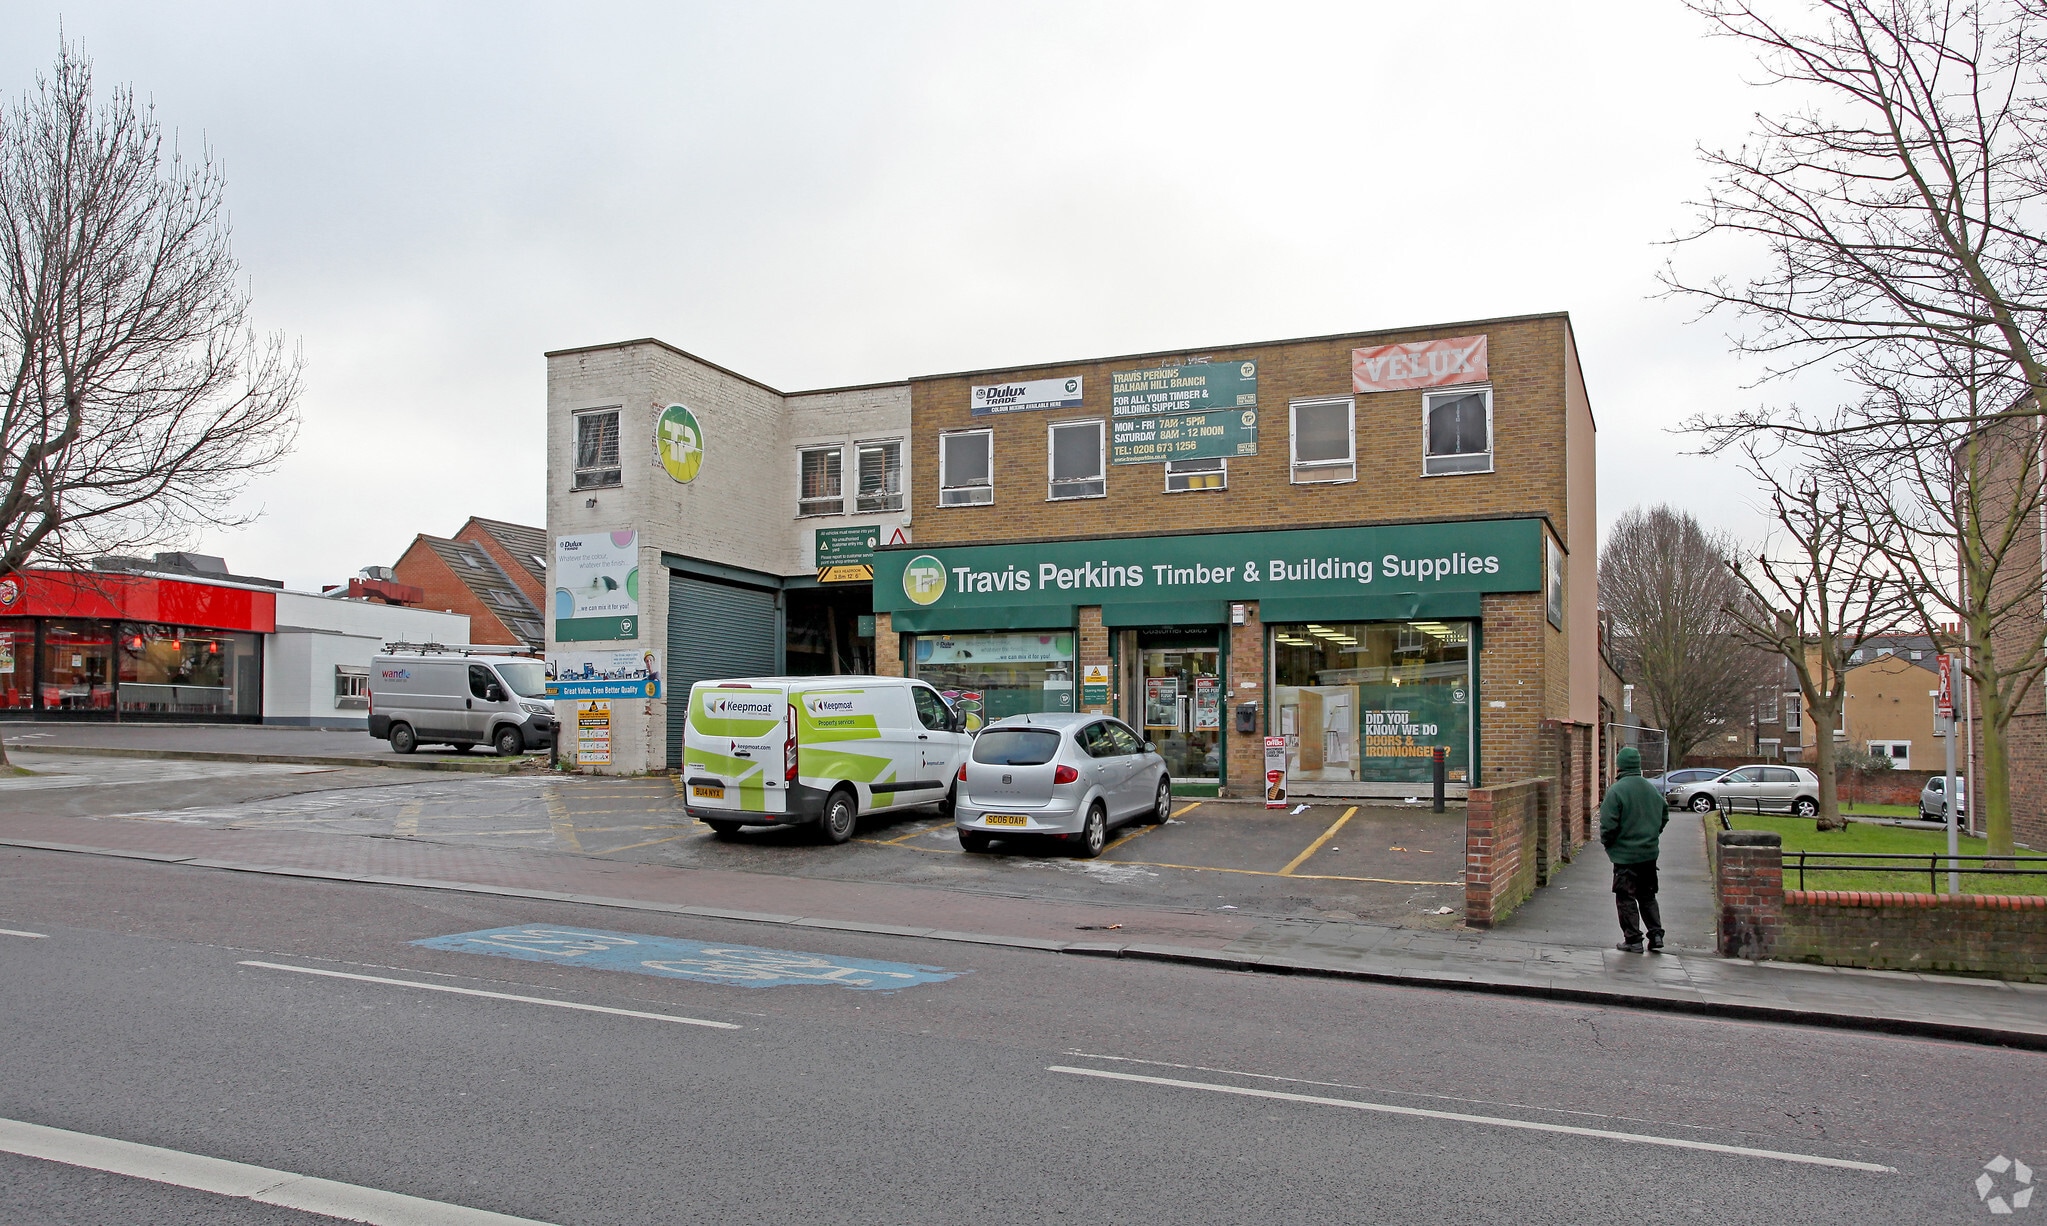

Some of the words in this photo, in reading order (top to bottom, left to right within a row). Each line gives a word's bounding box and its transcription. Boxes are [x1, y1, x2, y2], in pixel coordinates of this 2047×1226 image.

[1113, 372, 1142, 384] TRAVIS
[1144, 369, 1179, 381] PERKINS
[1114, 381, 1149, 393] BALHAM
[1151, 379, 1169, 391] HILL
[1171, 376, 1206, 388] BRANCH
[986, 386, 1027, 399] Dulux
[1114, 396, 1129, 406] FOR
[1130, 395, 1146, 405] ALL
[1148, 392, 1168, 403] YOUR
[1169, 390, 1200, 401] TIMBER
[1202, 390, 1209, 398] &
[986, 397, 1017, 405] TRADE
[1026, 402, 1049, 410] AVAILABLE
[1114, 404, 1151, 416] BUILDING
[1152, 401, 1191, 413] SUPPLIES
[1115, 422, 1134, 432] MON
[1142, 420, 1155, 431] FRI
[1159, 418, 1179, 429] 7AM
[1186, 416, 1206, 427] 5PM
[1115, 431, 1156, 444] SATURDAY
[1160, 430, 1180, 440] 8AM
[1188, 428, 1199, 438] 12
[1200, 426, 1225, 436] NOON
[665, 420, 697, 464] TP
[1114, 446, 1132, 456] TEL:
[1134, 444, 1155, 455] 0208
[1156, 442, 1173, 453] 673
[1175, 441, 1197, 451] 1256
[952, 565, 1030, 593] Travis
[1039, 561, 1144, 590] Perkins
[1152, 562, 1235, 586] Timber
[1243, 561, 1261, 583] &
[1269, 558, 1373, 584] Building
[1382, 552, 1500, 581] Supplies
[910, 567, 939, 593] TP
[382, 669, 410, 679] wandle
[578, 686, 592, 695] Value,
[593, 686, 605, 695] Even
[605, 686, 620, 694] Better
[621, 685, 638, 695] Quality
[728, 701, 772, 713] Keepmoat
[824, 701, 853, 711] Keepmoat
[1366, 714, 1384, 724] DID
[1387, 714, 1409, 724] YOU
[1366, 725, 1399, 735] KNOW
[1402, 725, 1419, 735] WE
[1423, 725, 1438, 735] DO
[1366, 736, 1403, 746] DOORS
[1406, 736, 1414, 746] &
[1366, 746, 1451, 757] IRONMONGE?
[696, 788, 708, 796] BU14
[709, 789, 721, 797] NYX
[989, 816, 1008, 824] SC06
[1009, 817, 1024, 825] OAH
